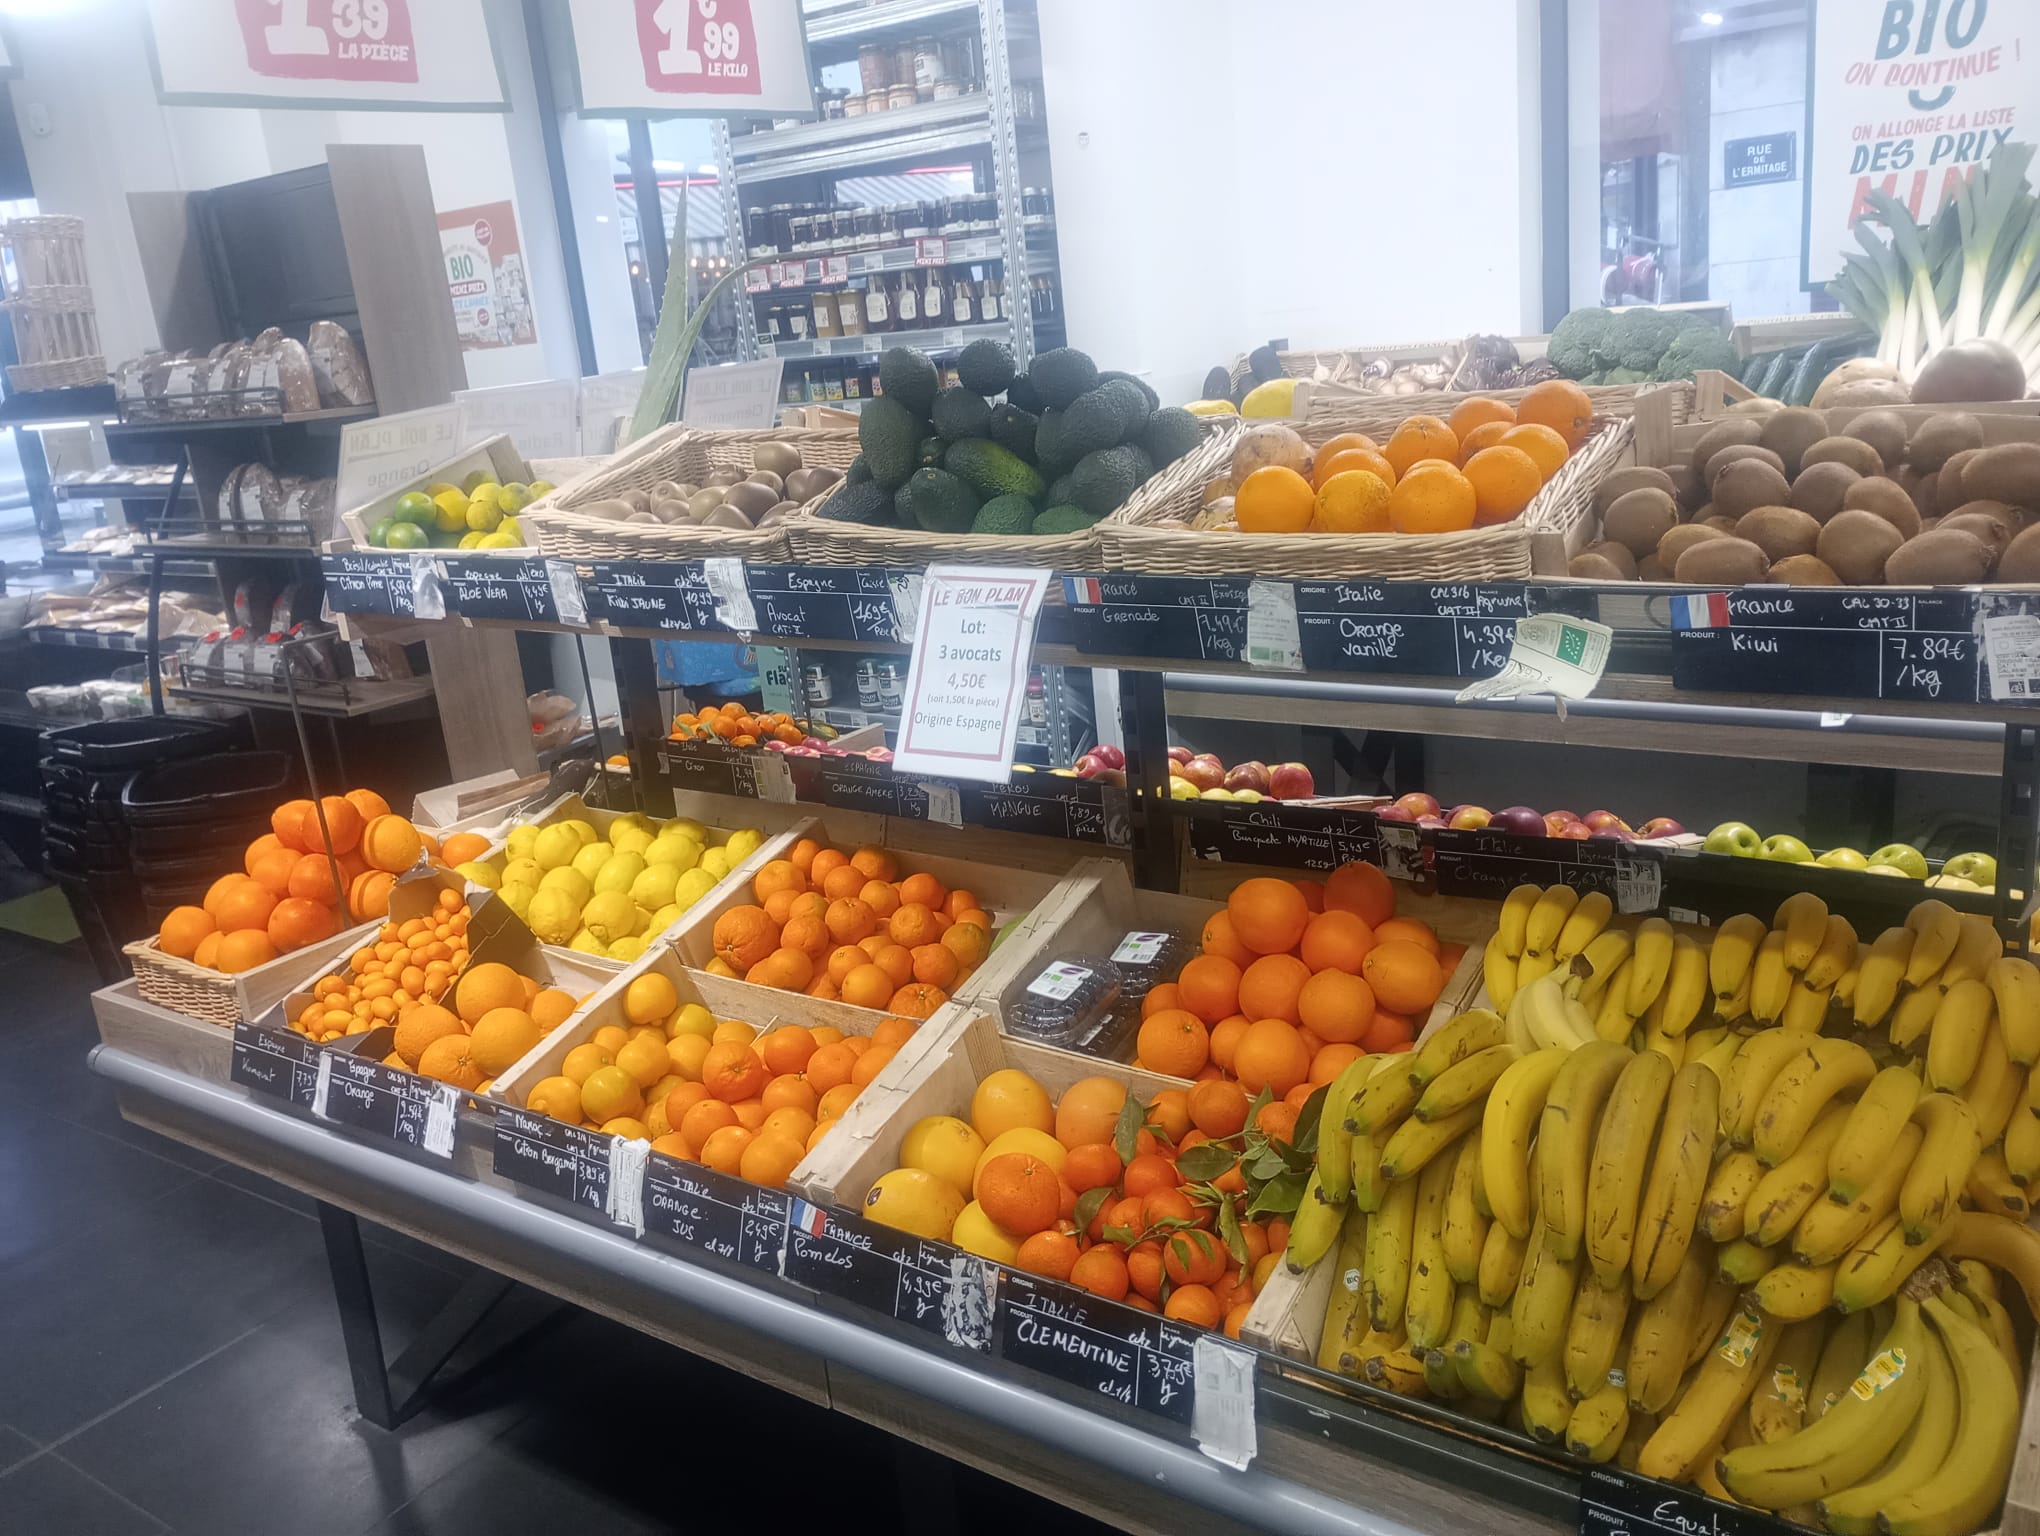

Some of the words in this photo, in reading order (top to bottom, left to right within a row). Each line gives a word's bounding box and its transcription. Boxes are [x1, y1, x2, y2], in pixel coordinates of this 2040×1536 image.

[332, 0, 388, 39] 39
[1874, 0, 1988, 60] BIO
[703, 21, 739, 60] 99
[338, 42, 358, 59] LA
[708, 63, 722, 77] LE
[723, 64, 748, 77] KILO
[1845, 62, 1878, 86] ON
[1852, 124, 1872, 141] ON
[1877, 116, 1944, 138] ALLONGE
[1947, 113, 1966, 130] LA
[1972, 106, 2016, 127] LISTE
[1747, 143, 1772, 156] RUE
[1850, 139, 1914, 174] DES
[1753, 155, 1765, 163] DE
[1732, 161, 1788, 178] L'ERMITAGE
[450, 254, 474, 280] BIO
[787, 572, 836, 592] Espagne
[458, 587, 482, 601] ALOE
[484, 587, 508, 601] VERA
[934, 590, 951, 606] LE
[955, 588, 982, 604] BON
[985, 586, 1025, 603] PLAN
[1335, 585, 1384, 603] Italie
[631, 597, 666, 610] JAUNE
[767, 601, 806, 623] Avocat
[1842, 597, 1870, 610] CAL
[960, 619, 986, 634] Lot:
[1731, 632, 1779, 653] Kiwi
[939, 645, 947, 659] 3
[950, 645, 1002, 661] avocats
[947, 672, 987, 690] 4,50€
[945, 695, 965, 705] 1,50€
[967, 695, 975, 704] la
[976, 697, 1000, 707] pièce)
[914, 712, 953, 728] Origine
[956, 714, 1002, 731] Espagne
[990, 800, 1042, 817] MANGUE
[1249, 812, 1281, 828] Chili
[1287, 834, 1330, 850] MYRTILLE
[672, 1219, 694, 1241] JUS
[823, 1217, 873, 1249] FRANCE
[794, 1237, 853, 1269] Pomelos
[1011, 1276, 1033, 1289] ORIGINE
[1009, 1307, 1033, 1320] PRODUIT
[1590, 1470, 1624, 1488] ORIGINE
[1588, 1507, 1624, 1526] PRODUIT
